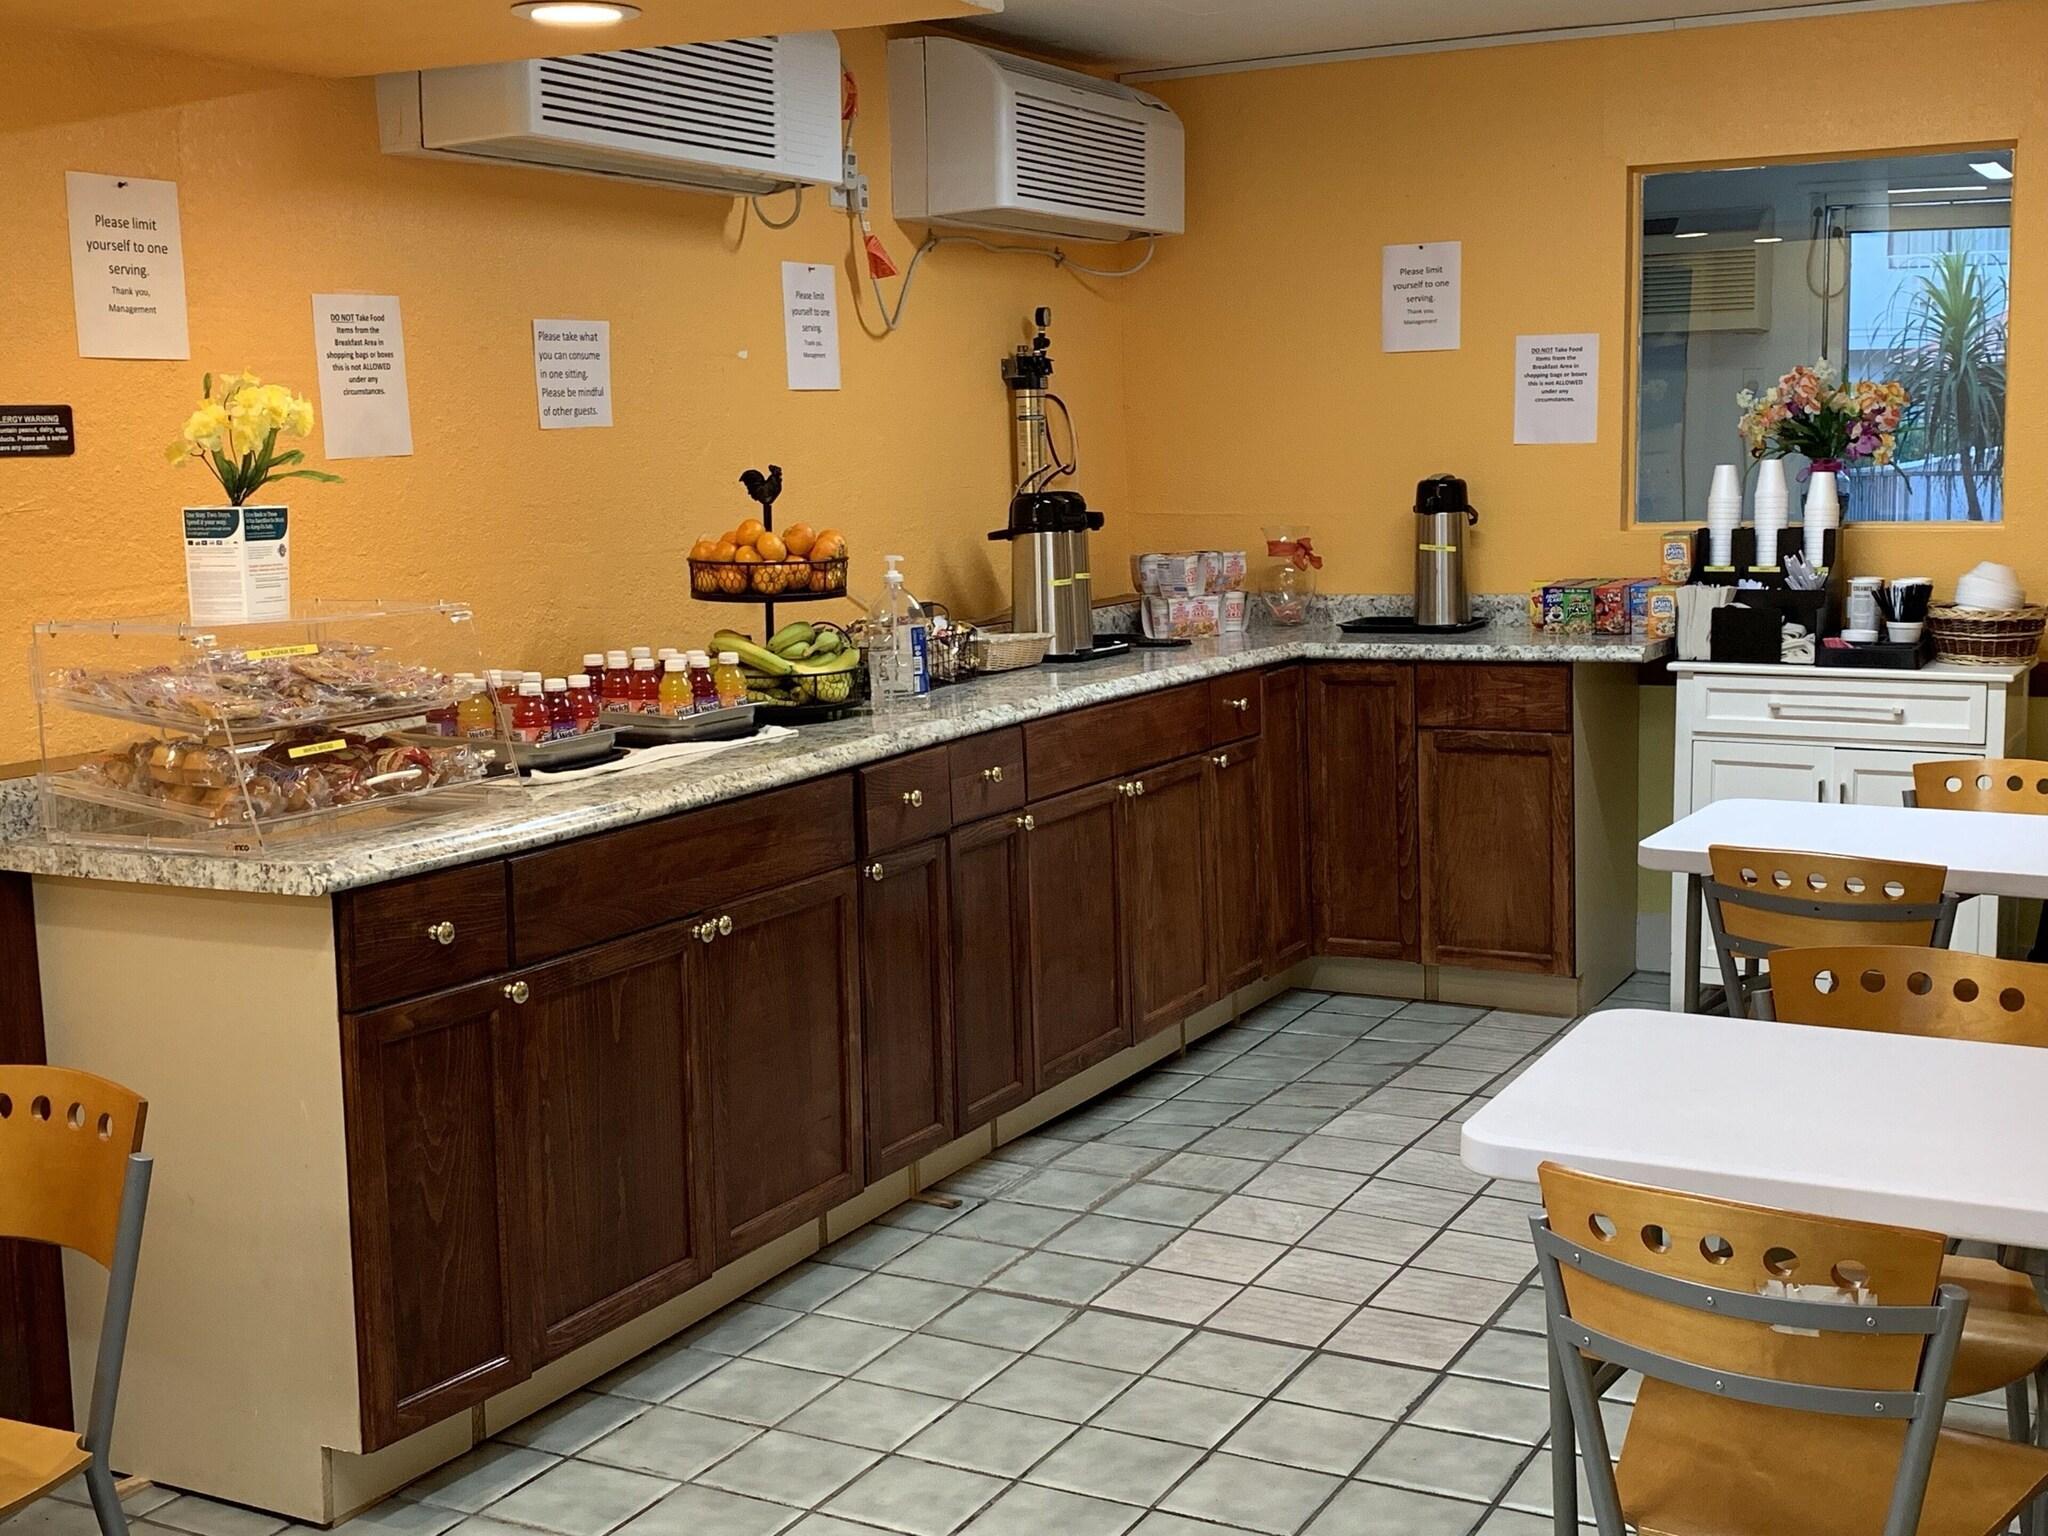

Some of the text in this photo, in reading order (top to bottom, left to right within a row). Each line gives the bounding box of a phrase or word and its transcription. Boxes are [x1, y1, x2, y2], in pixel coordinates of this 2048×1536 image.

[95, 214, 157, 231] Please limit
[87, 240, 168, 254] yourself to one
[108, 264, 149, 279] serving.
[1400, 266, 1443, 276] Please limit
[112, 286, 133, 295] Thank
[1393, 280, 1423, 291] yourself
[796, 290, 825, 300] Please limit
[108, 304, 157, 314] Management
[792, 308, 813, 317] yourself
[355, 326, 369, 334] from
[538, 331, 598, 341] Please take what
[326, 351, 354, 360] shopping
[355, 351, 369, 360] bags
[539, 352, 601, 361] you can consume
[540, 369, 588, 381] in one sitting.
[343, 388, 386, 396] circumstances.
[542, 386, 604, 397] Please be mindful
[543, 406, 598, 418] of other guests.
[24, 415, 60, 423] WARNING
